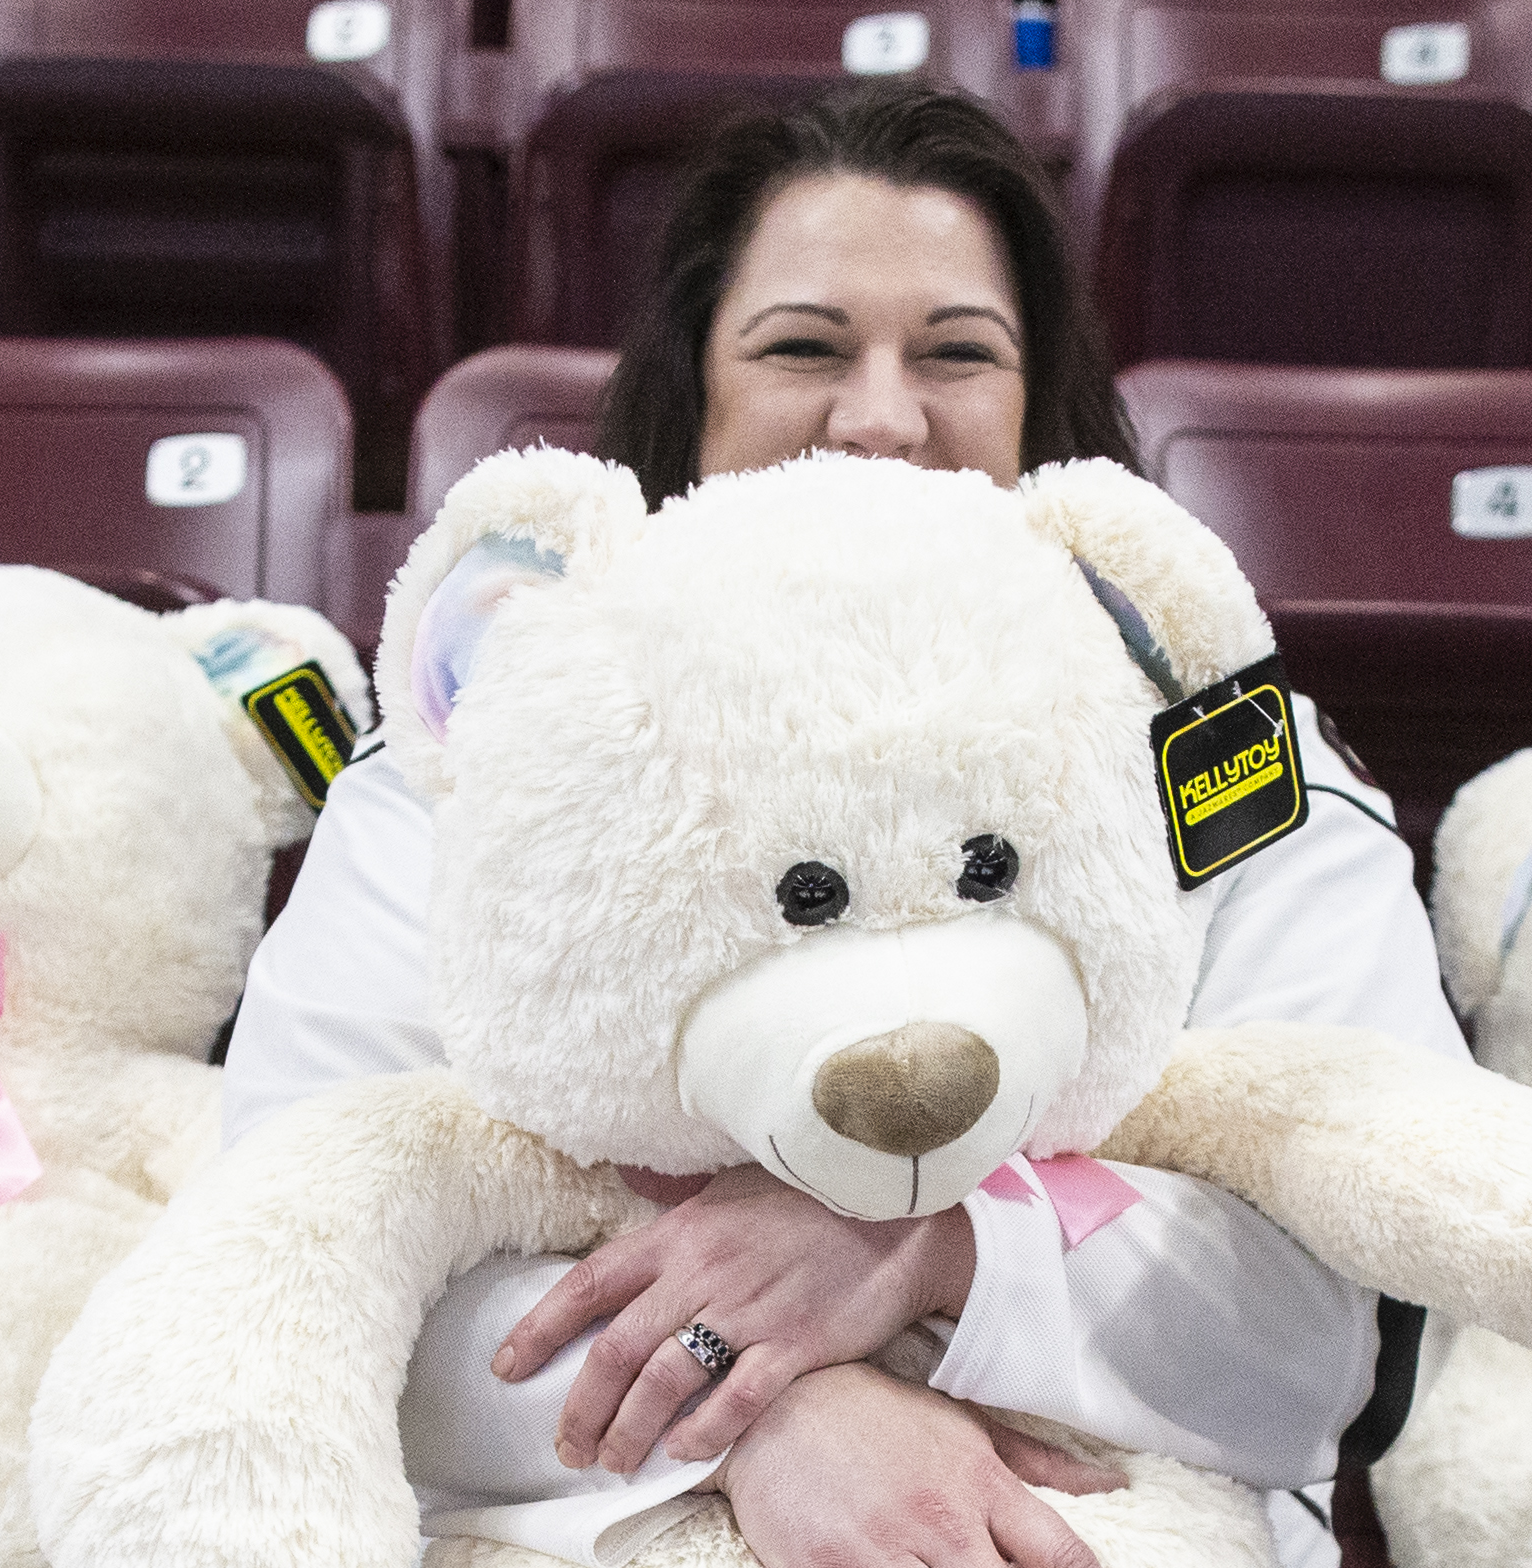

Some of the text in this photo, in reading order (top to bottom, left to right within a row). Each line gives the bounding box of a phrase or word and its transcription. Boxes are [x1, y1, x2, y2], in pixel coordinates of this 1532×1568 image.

[179, 446, 210, 490] 2
[1487, 481, 1521, 517] 4
[1179, 734, 1280, 809] KELLYTOY
